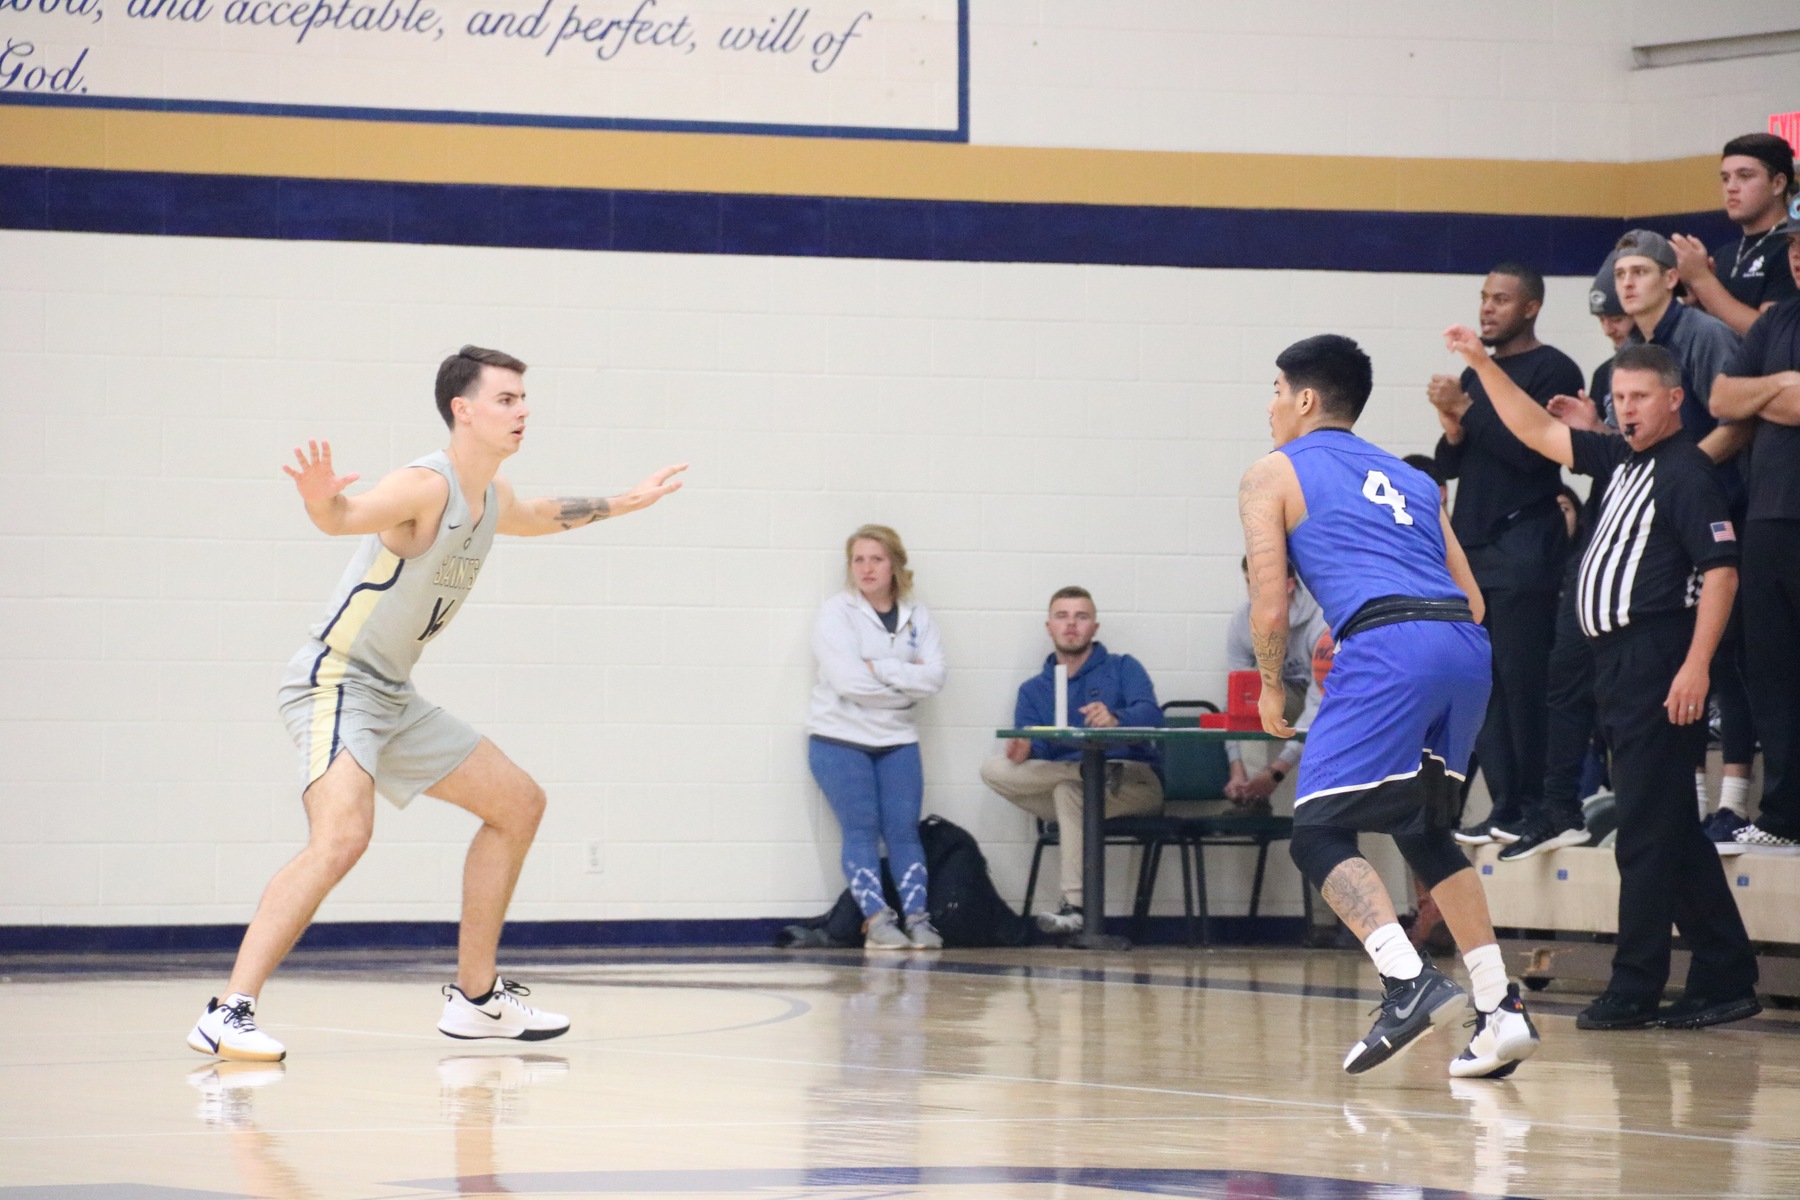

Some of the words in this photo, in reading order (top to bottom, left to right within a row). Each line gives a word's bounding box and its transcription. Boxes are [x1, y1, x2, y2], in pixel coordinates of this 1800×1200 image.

[0, 37, 89, 93] God.
[224, 0, 443, 44] acceptable,
[466, 0, 551, 38] and
[545, 0, 697, 60] perfect,
[719, 7, 811, 53] will
[812, 11, 873, 73] of
[1362, 469, 1414, 526] 4
